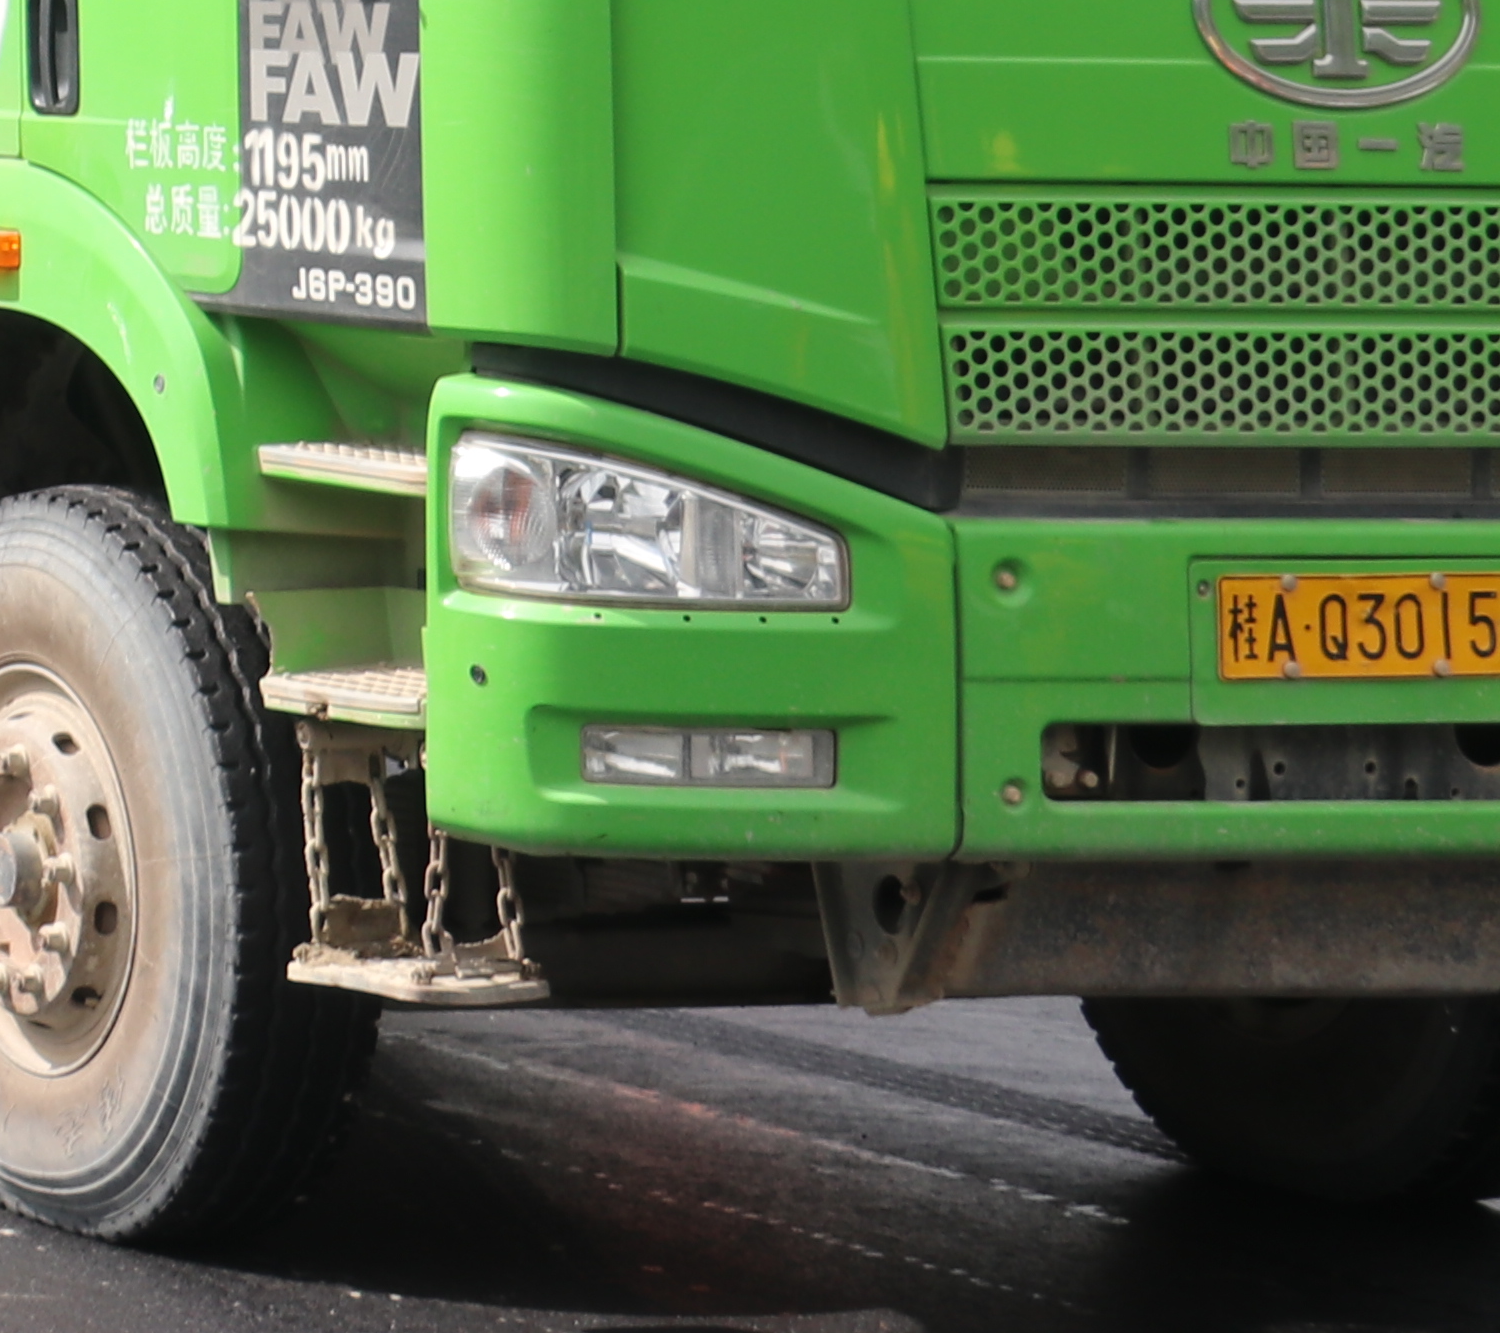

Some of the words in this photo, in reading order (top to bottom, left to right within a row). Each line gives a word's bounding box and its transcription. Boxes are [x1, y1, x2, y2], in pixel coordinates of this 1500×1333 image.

[250, 48, 420, 128] FAW
[1228, 119, 1464, 172] 中国一汽
[292, 267, 417, 311] J6P-390
